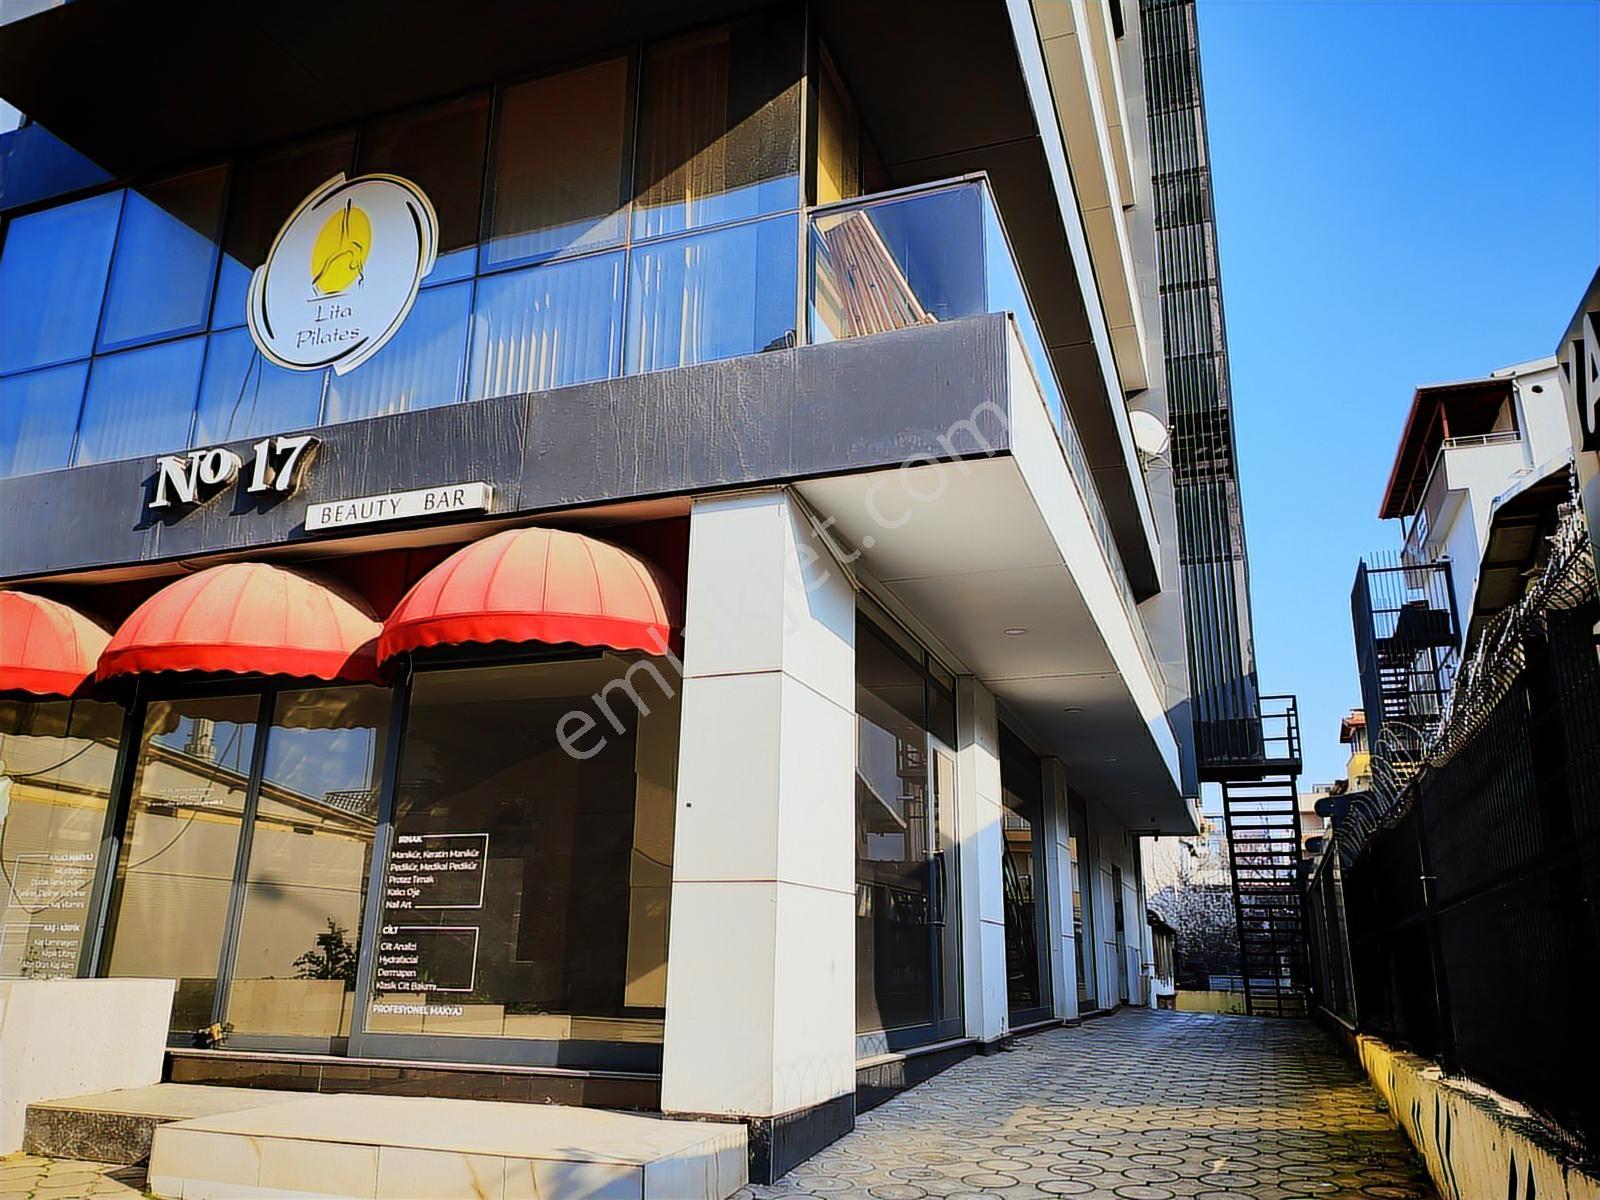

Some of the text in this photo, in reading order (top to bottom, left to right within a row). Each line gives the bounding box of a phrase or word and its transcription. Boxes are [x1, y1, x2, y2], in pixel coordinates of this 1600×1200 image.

[314, 304, 352, 322] Lita
[296, 327, 360, 348] Pilates
[247, 435, 320, 493] 17
[320, 489, 466, 525] BEAUTY BAR
[385, 900, 412, 909] Nail Art
[377, 968, 416, 978] Dermapen
[397, 981, 410, 990] Cilt
[372, 1004, 429, 1015] PROFESYONEL
